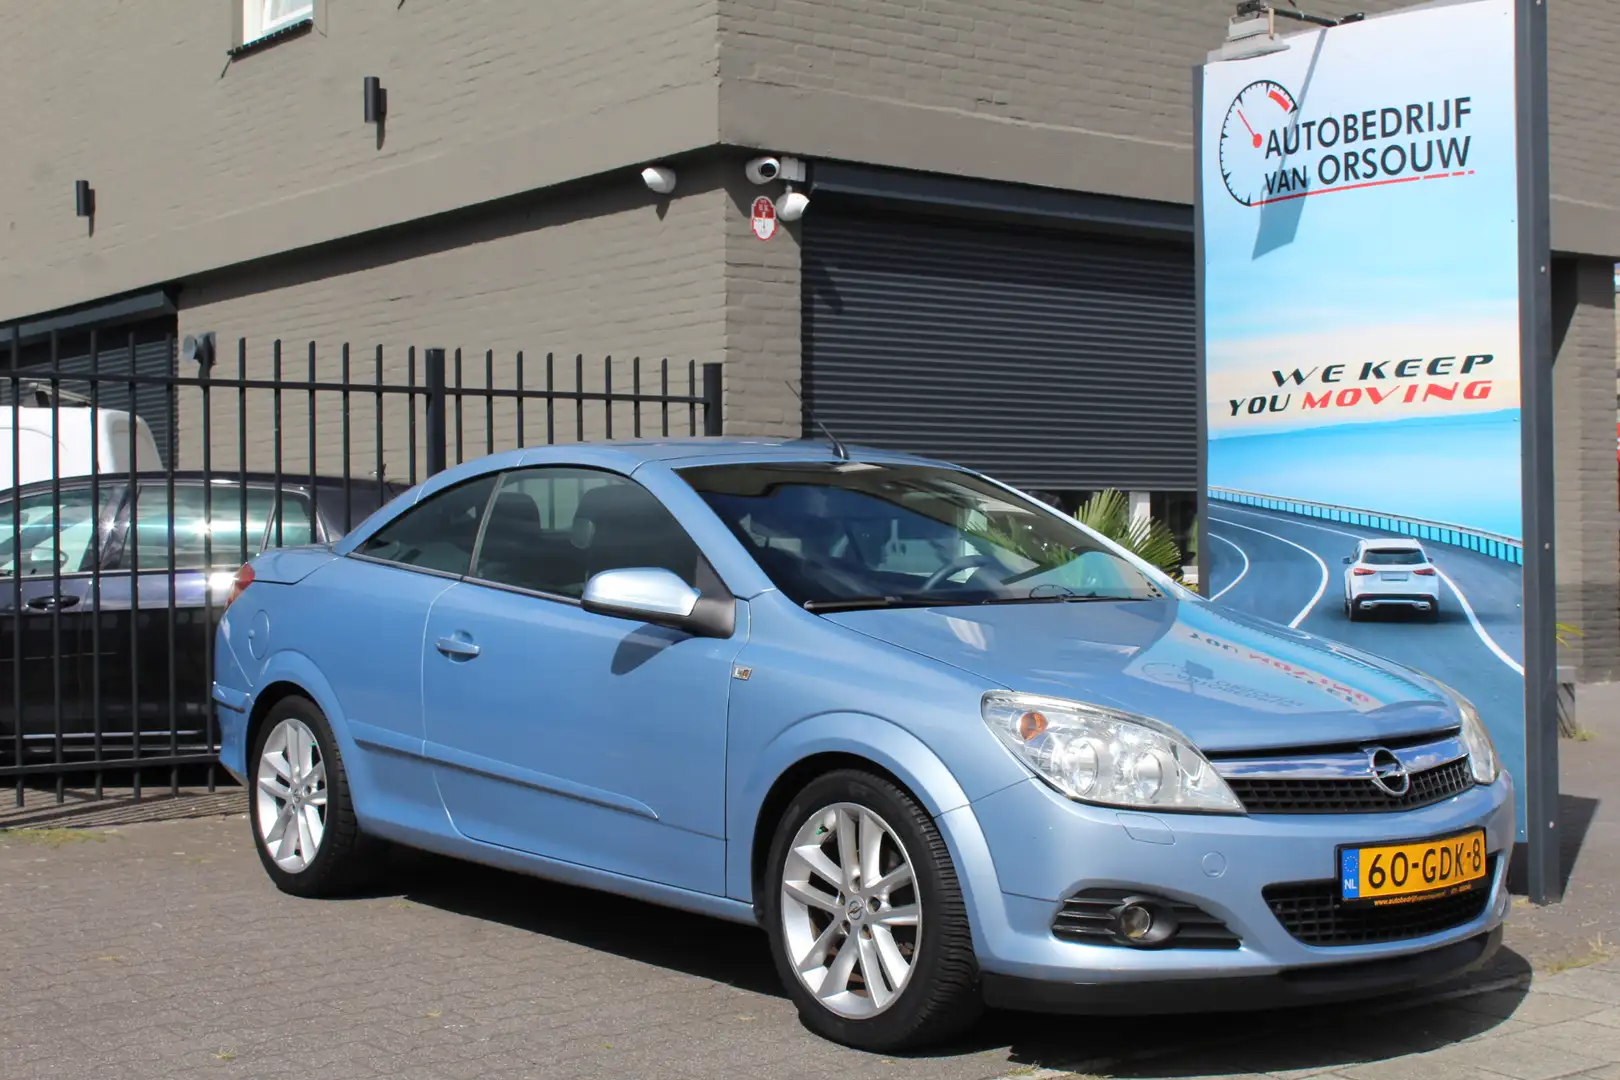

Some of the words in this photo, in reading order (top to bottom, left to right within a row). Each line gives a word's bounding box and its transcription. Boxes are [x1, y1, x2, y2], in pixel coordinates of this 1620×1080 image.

[1265, 96, 1471, 159] AUTOBEDRIJF
[1265, 165, 1307, 195] VAN
[1317, 135, 1471, 185] ORSOUW
[1272, 364, 1346, 388] WE
[1358, 354, 1494, 381] KEEP
[1229, 393, 1291, 416] YOU
[1301, 380, 1493, 410] MOVING
[1344, 879, 1357, 890] NL
[1368, 838, 1481, 889] 60-GDK-8
